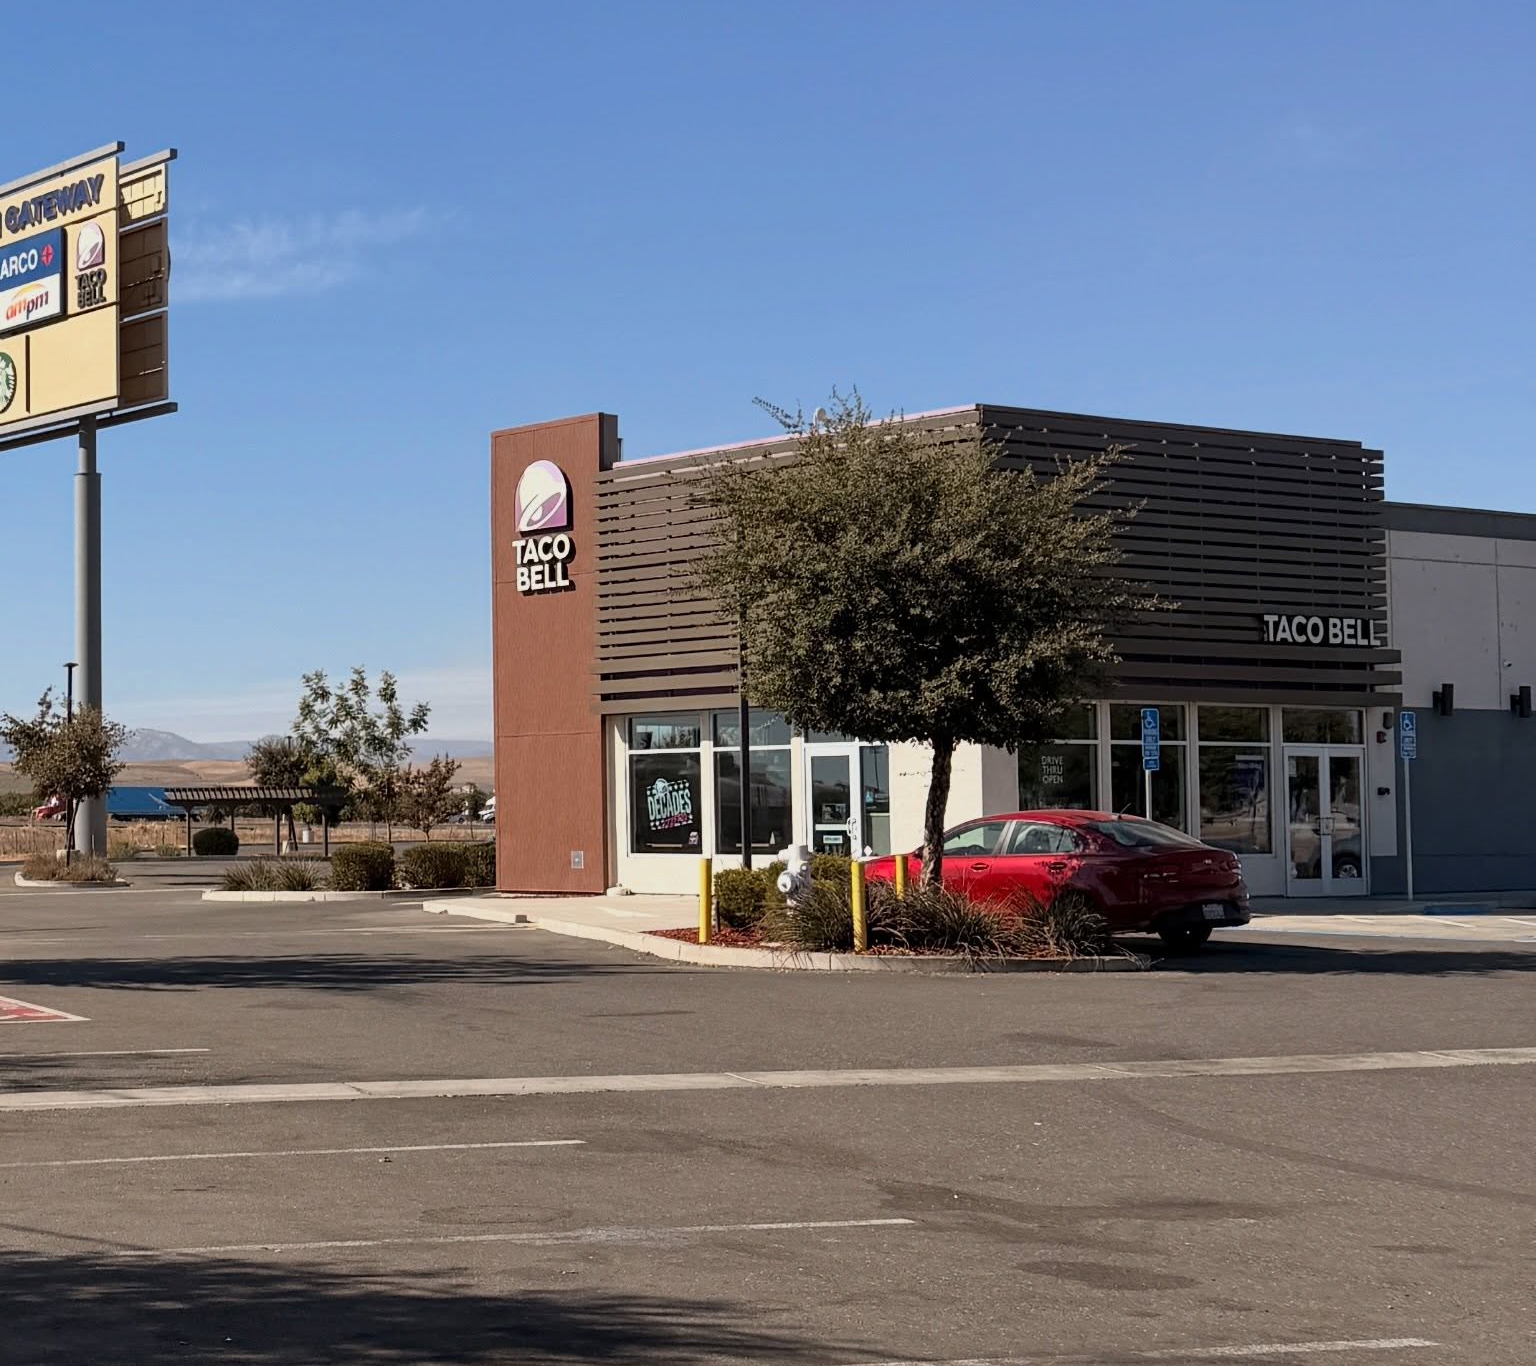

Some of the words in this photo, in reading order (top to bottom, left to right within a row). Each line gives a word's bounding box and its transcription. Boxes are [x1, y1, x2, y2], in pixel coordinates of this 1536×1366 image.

[5, 174, 104, 233] GATEWAY
[0, 248, 39, 280] ARCO
[75, 268, 107, 291] TACO
[6, 291, 49, 320] ampm
[77, 285, 107, 309] BELL
[512, 534, 570, 565] TACO
[517, 562, 570, 592] BELL
[1264, 615, 1324, 644] TACO
[1328, 618, 1381, 646] BELL
[1042, 756, 1064, 765] DRIVE
[1043, 765, 1063, 774] THRU
[1042, 775, 1064, 784] OPEN
[648, 789, 692, 821] DECADES
